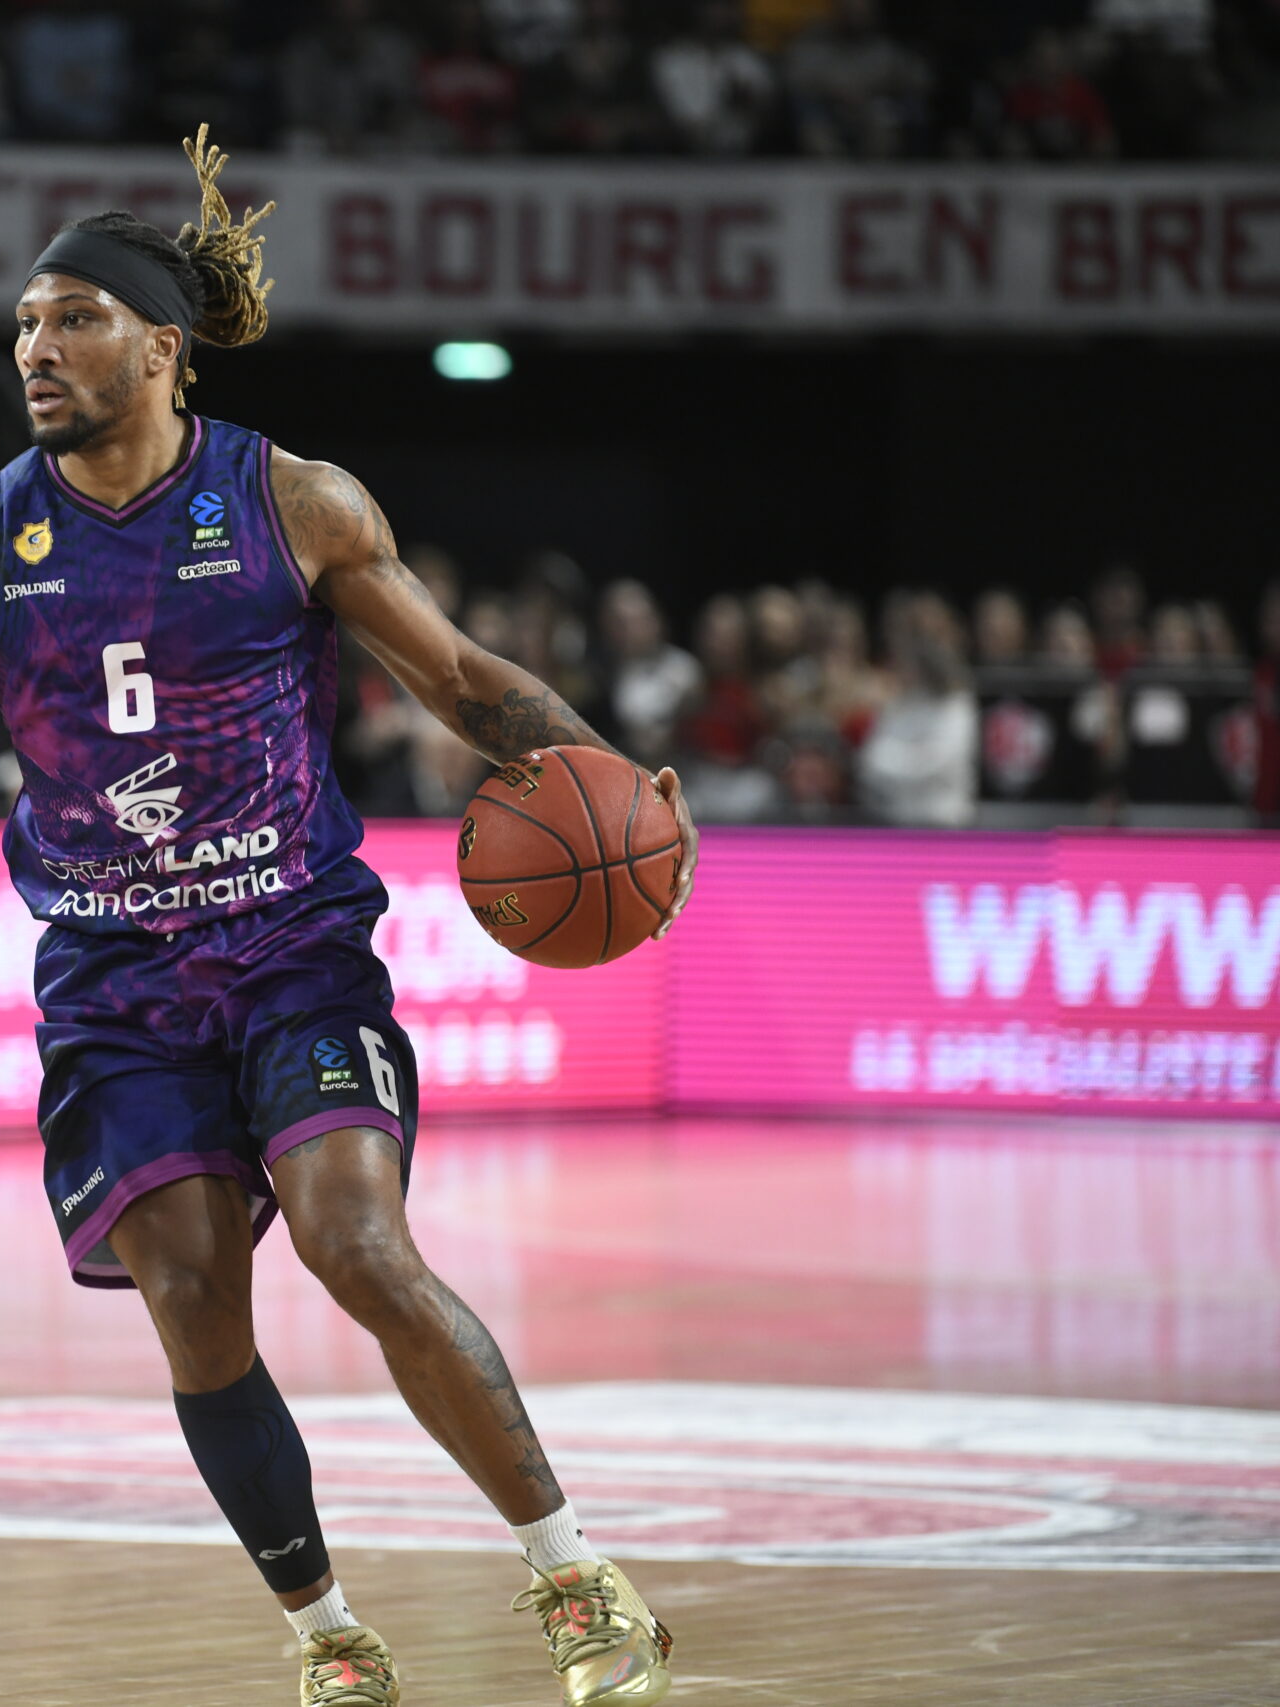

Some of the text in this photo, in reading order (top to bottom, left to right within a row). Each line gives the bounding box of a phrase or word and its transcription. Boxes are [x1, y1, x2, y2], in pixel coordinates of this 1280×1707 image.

[332, 192, 776, 304] BOURG
[836, 192, 996, 298] EN
[1054, 194, 1280, 303] BRE
[192, 539, 230, 550] EuroCup
[4, 579, 65, 601] SPALDING
[178, 560, 241, 580] oneteam
[102, 641, 156, 734] 6
[124, 864, 286, 913] Canaria
[320, 1081, 359, 1091] EuroCup
[358, 1025, 400, 1117] 6
[61, 1165, 105, 1217] SPALDING
